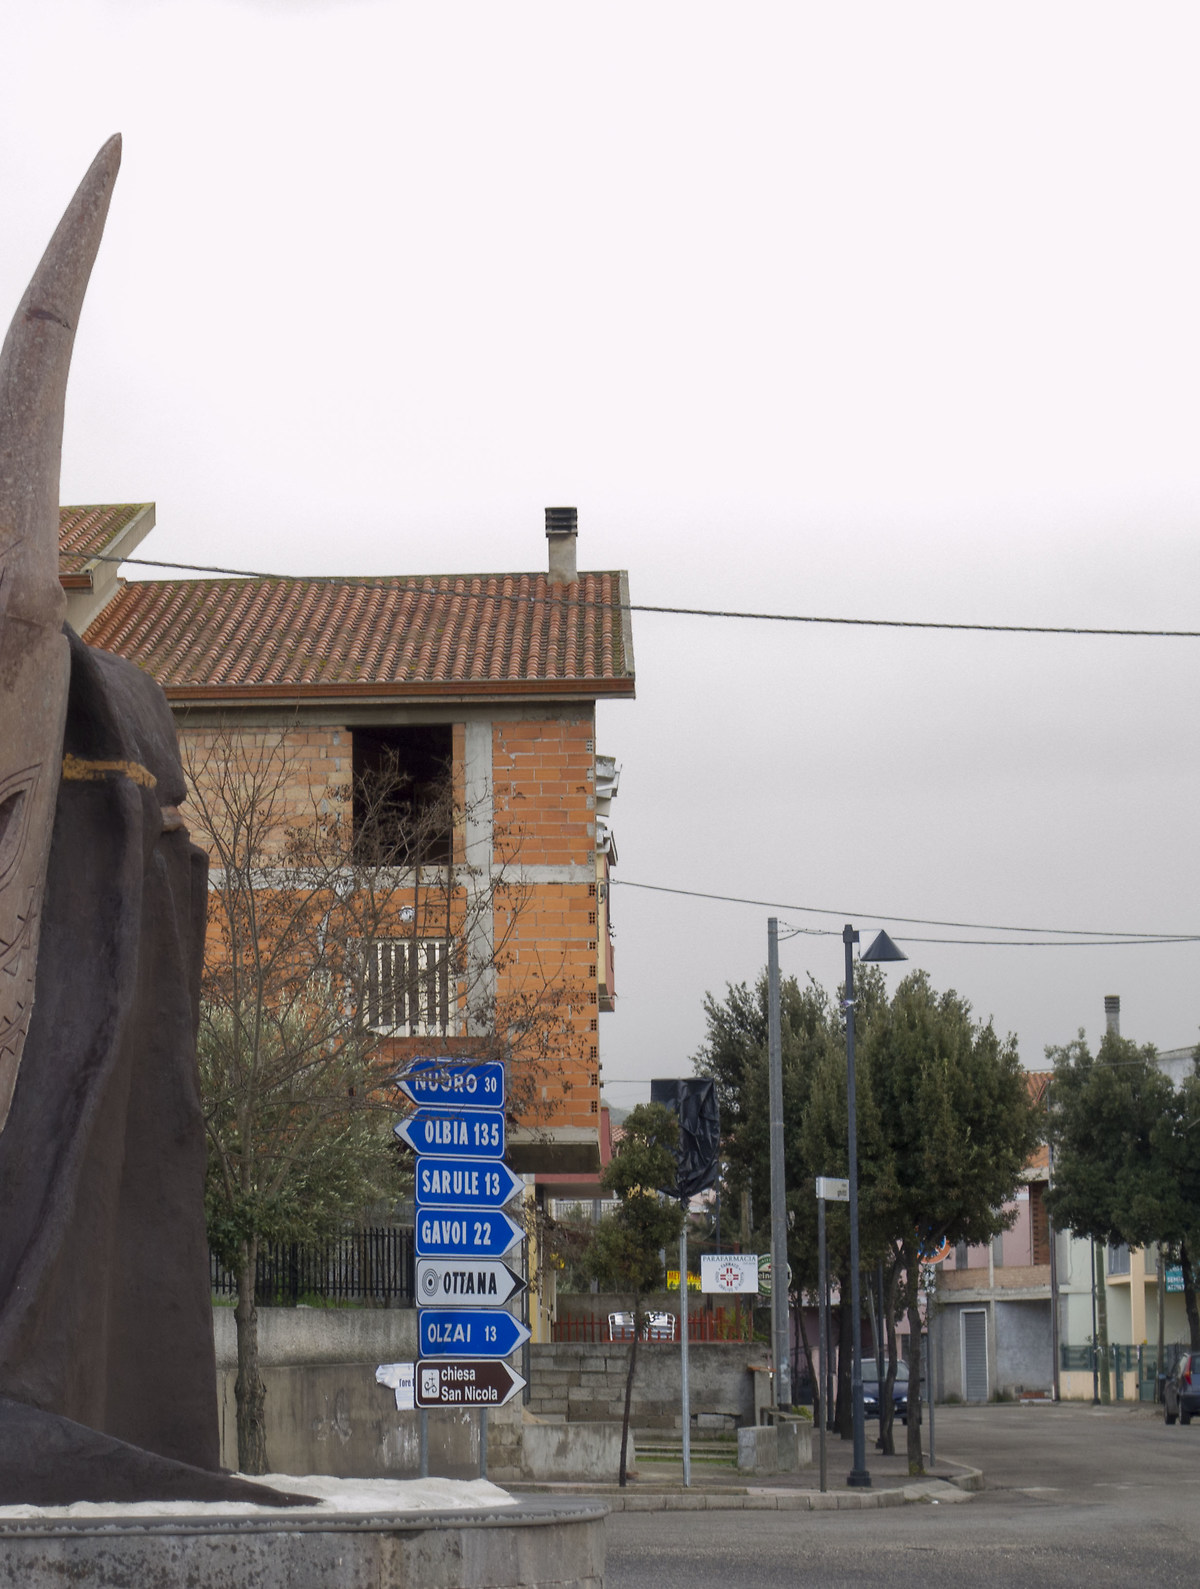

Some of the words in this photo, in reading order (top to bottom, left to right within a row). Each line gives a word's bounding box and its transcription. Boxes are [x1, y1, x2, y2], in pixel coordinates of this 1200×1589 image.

[415, 1072, 477, 1093] NUORO
[484, 1077, 497, 1093] 30
[424, 1120, 468, 1145] OLBIA
[474, 1122, 499, 1146] 135
[422, 1170, 479, 1195] SARULE
[485, 1172, 500, 1196] 13
[422, 1220, 467, 1245] GAVOI
[473, 1222, 491, 1246] 22
[443, 1272, 497, 1295] OTTANA
[427, 1323, 471, 1343] OLZAI
[485, 1325, 497, 1342] 13
[441, 1366, 476, 1381] chiesa
[441, 1386, 462, 1401] San
[465, 1386, 498, 1401] Nicola
